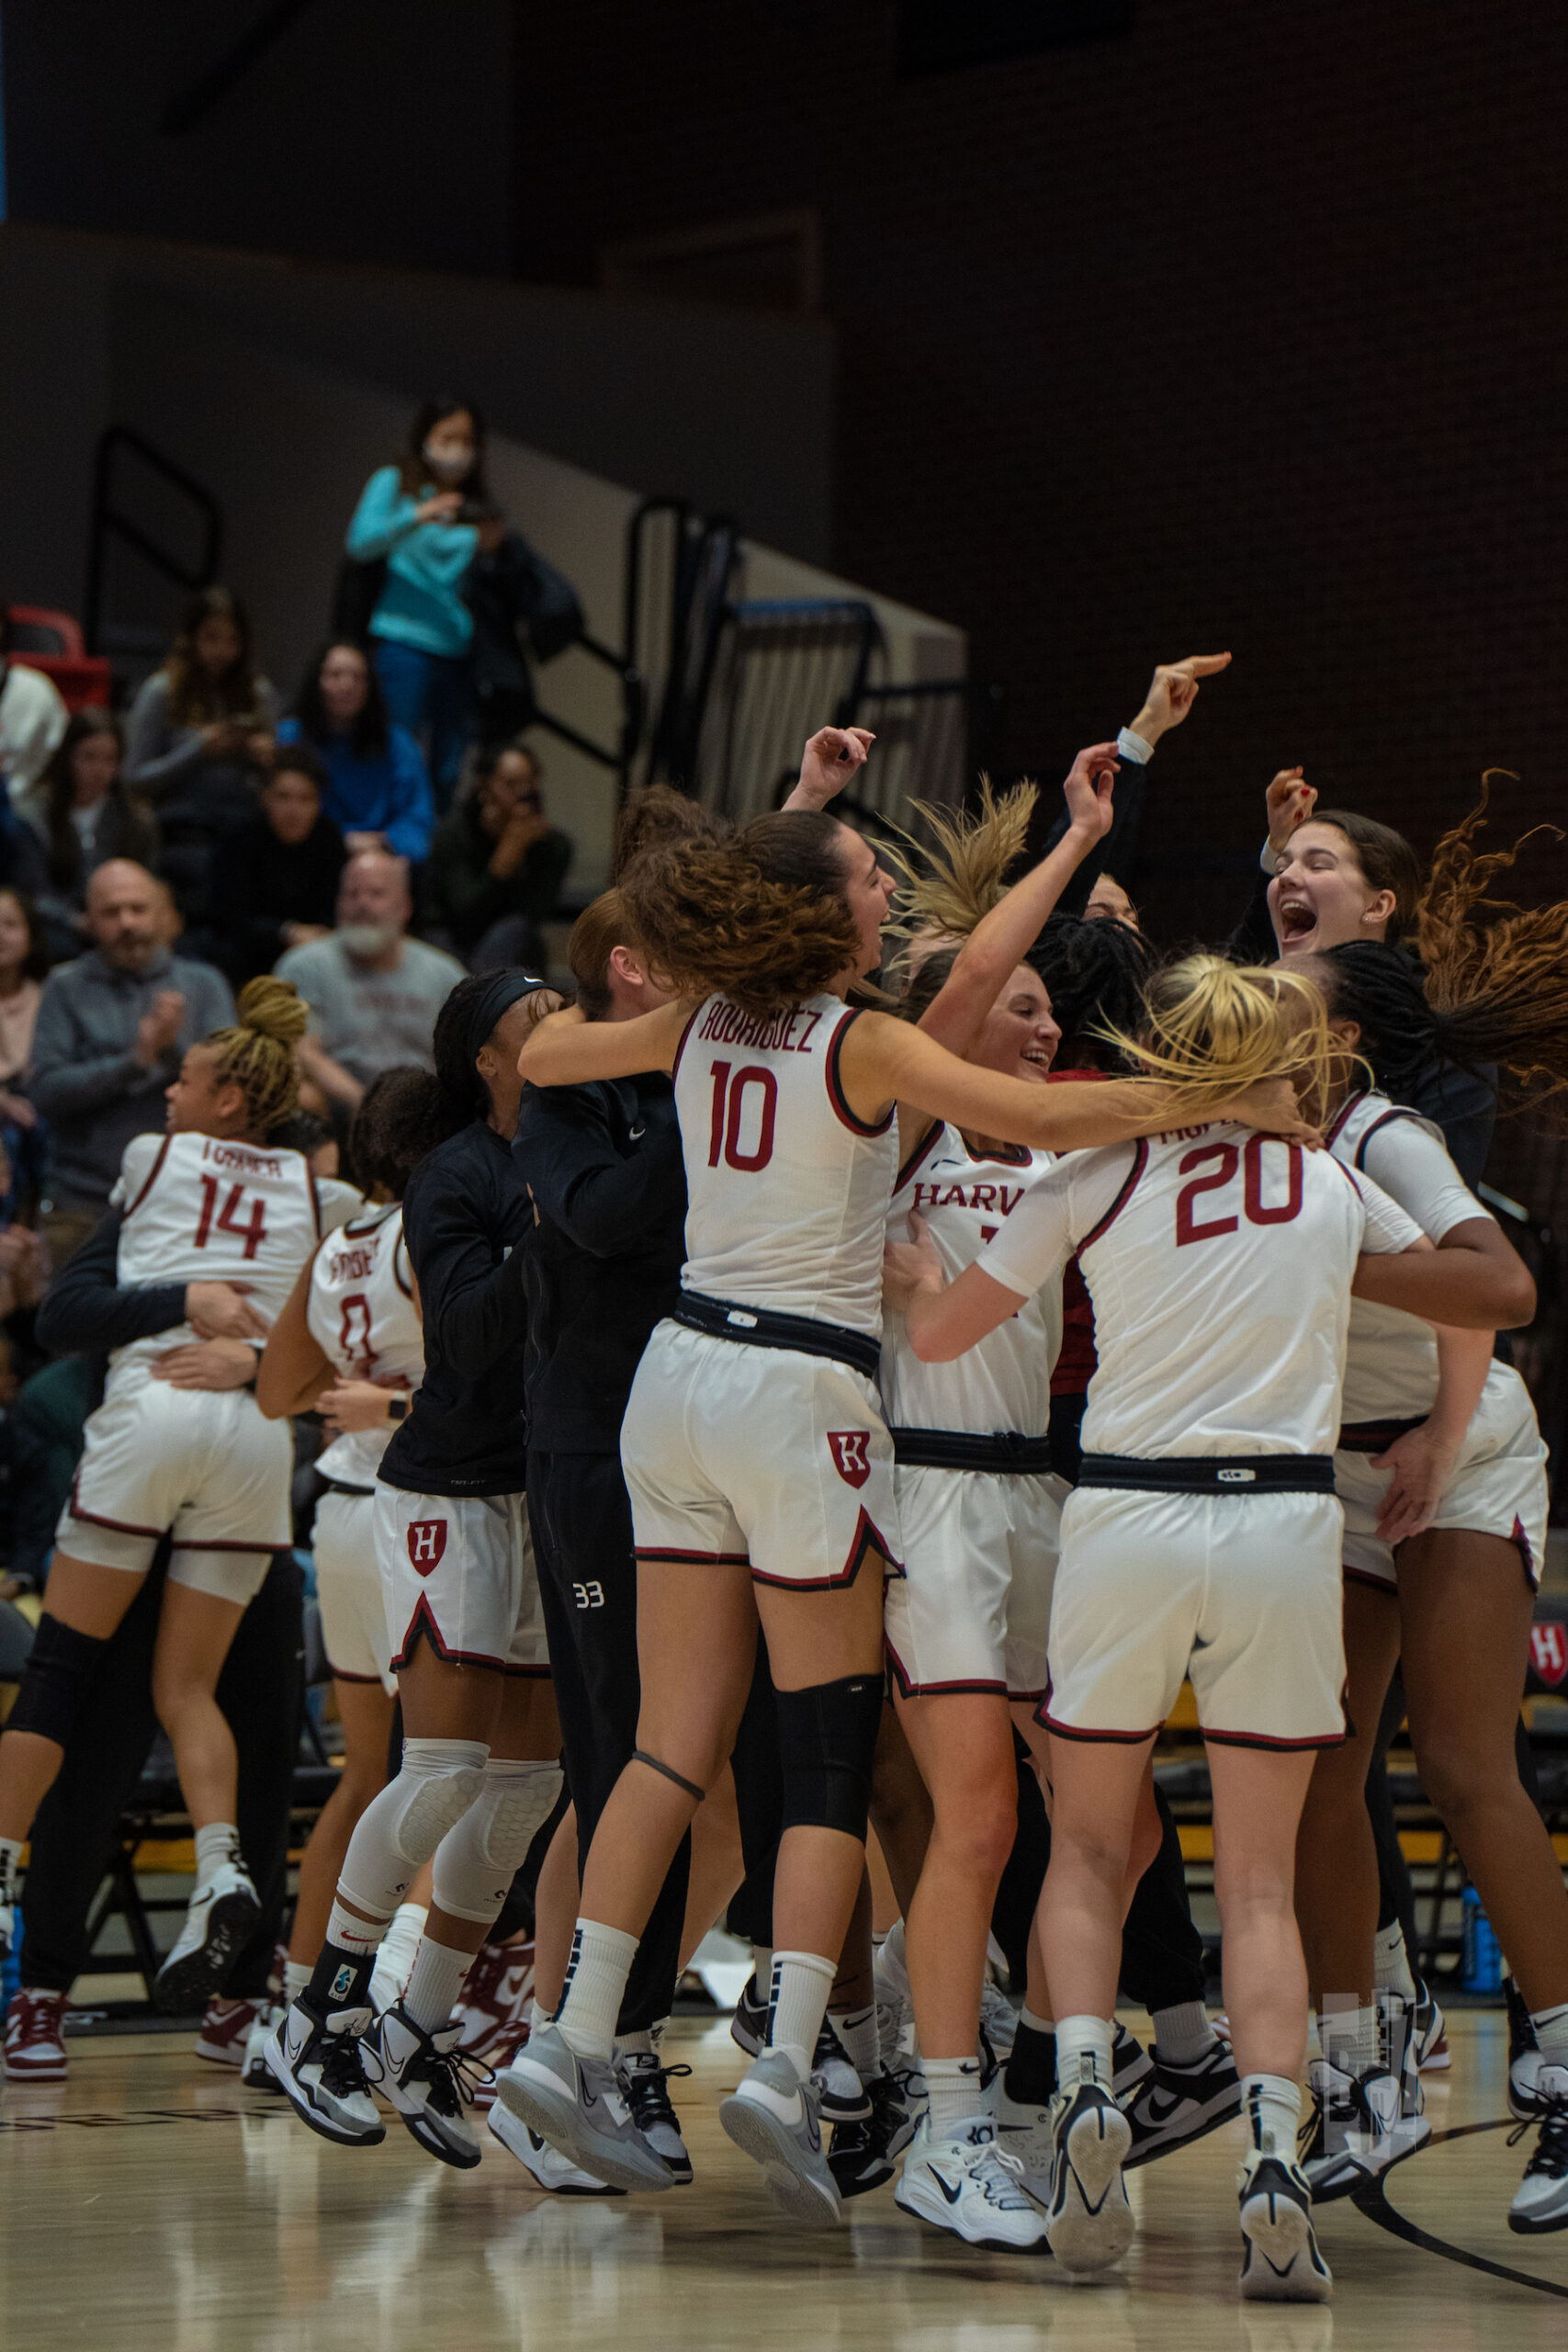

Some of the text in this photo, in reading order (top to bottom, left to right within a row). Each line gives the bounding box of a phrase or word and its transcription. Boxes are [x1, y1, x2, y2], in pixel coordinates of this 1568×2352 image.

[698, 1001, 823, 1053] RODRIGUEZ
[708, 1059, 778, 1172] 10
[1176, 1131, 1303, 1248] 20
[194, 1173, 266, 1260] 14
[837, 1436, 866, 1472] H
[414, 1525, 438, 1561] H
[572, 1580, 605, 1609] 33
[1530, 1625, 1562, 1669] H
